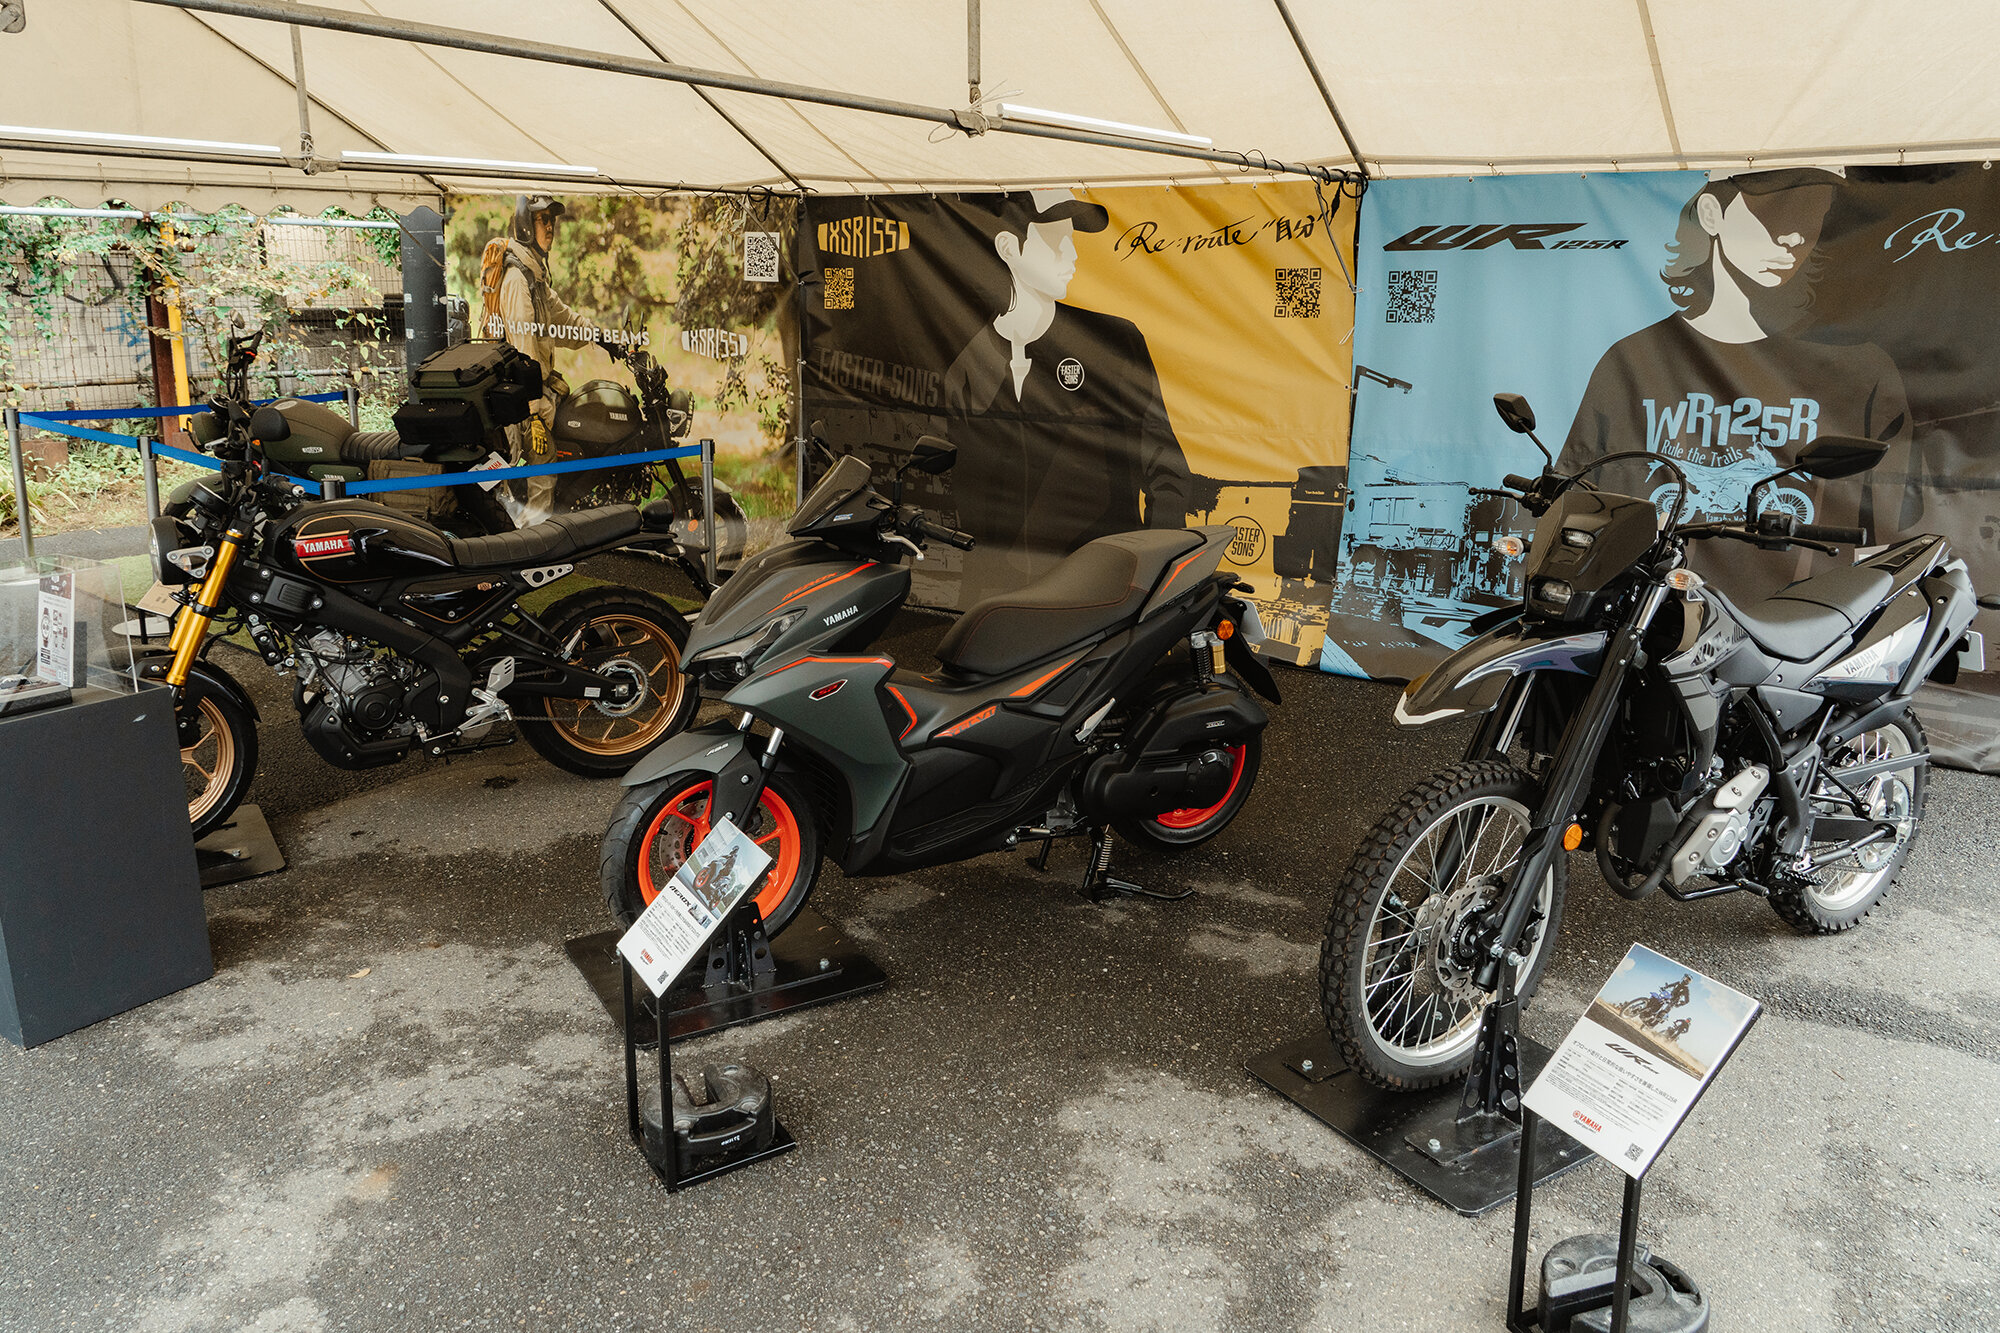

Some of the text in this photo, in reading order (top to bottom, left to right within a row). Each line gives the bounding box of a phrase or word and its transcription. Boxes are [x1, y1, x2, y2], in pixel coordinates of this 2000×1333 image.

[508, 321, 545, 337] HAPPY
[548, 324, 600, 342] OUTSIDE
[603, 328, 650, 345] BEAMS
[815, 345, 940, 408] FASTER SONS
[1643, 393, 1820, 454] WR125R
[1661, 439, 1744, 467] Rule the Trails
[303, 539, 344, 553] YAMAHA
[1231, 541, 1255, 557] SONS
[823, 605, 859, 627] YAMAHA
[1843, 649, 1879, 675] YAMAHA
[1579, 1113, 1602, 1133] YAMAHA
